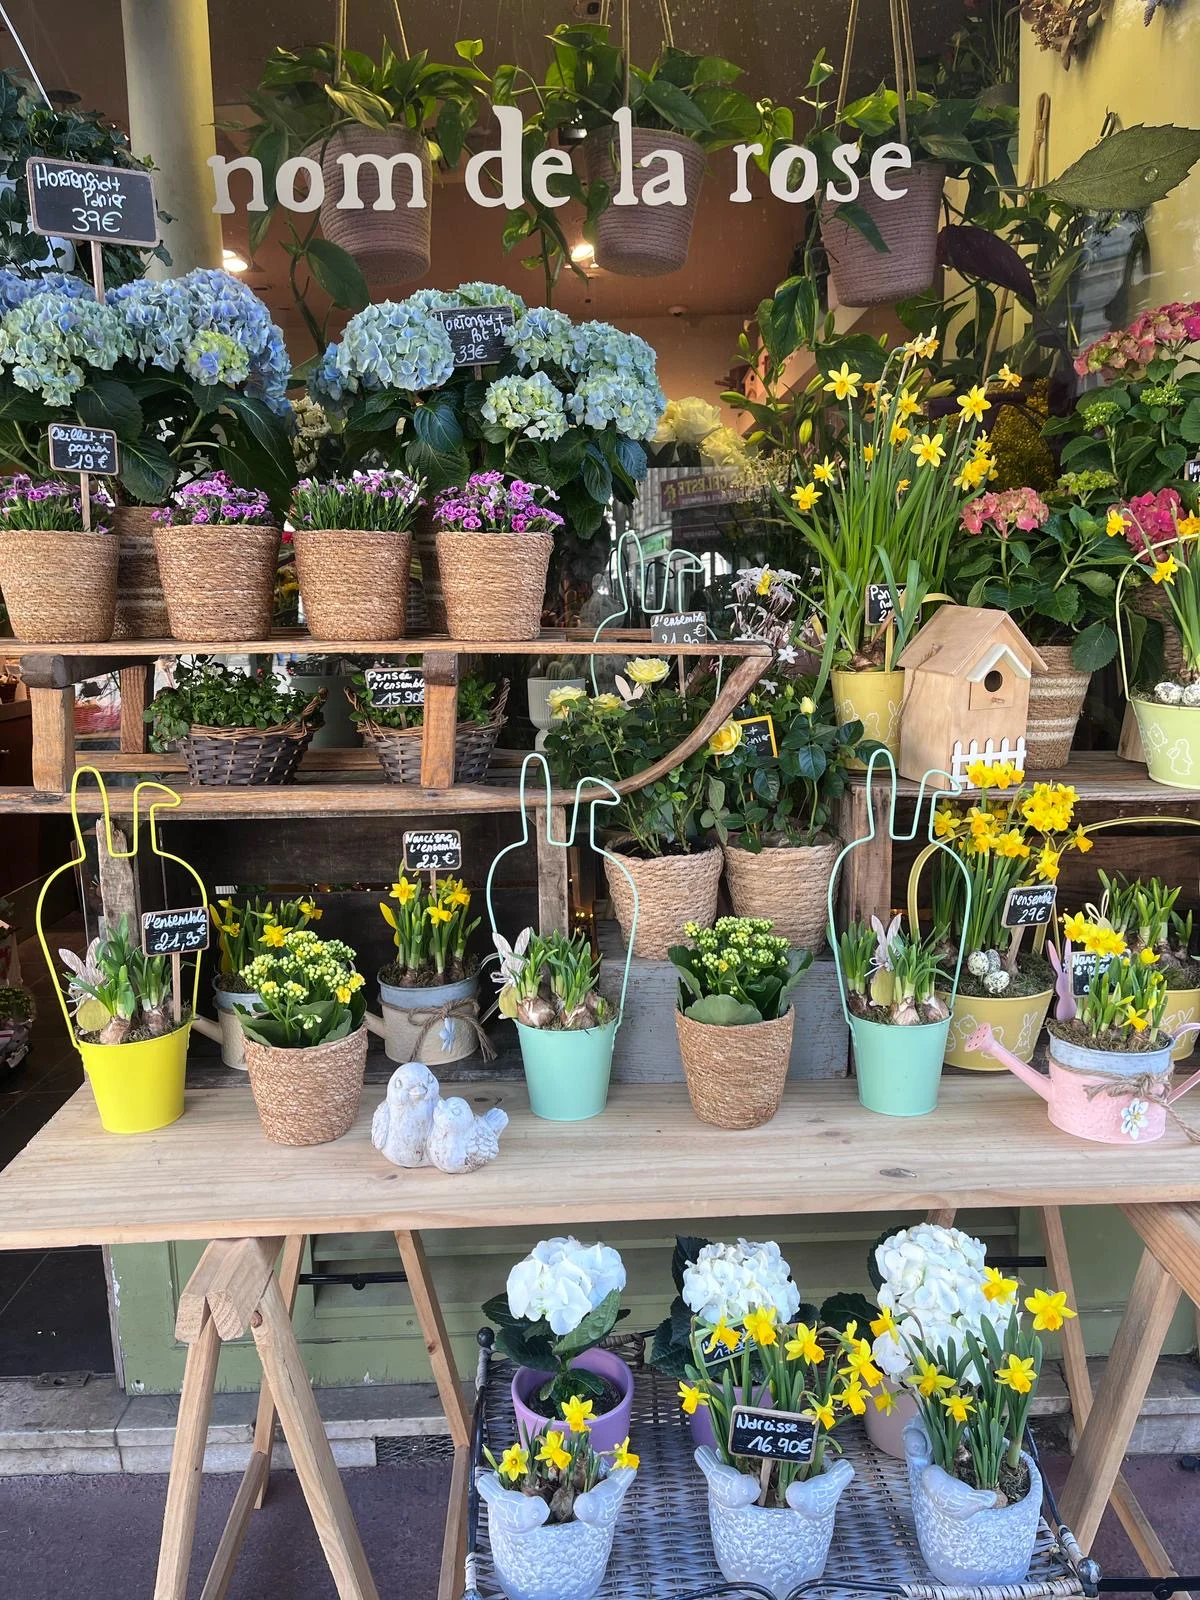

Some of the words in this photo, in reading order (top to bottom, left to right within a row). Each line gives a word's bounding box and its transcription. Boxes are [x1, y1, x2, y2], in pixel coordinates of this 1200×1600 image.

[207, 153, 427, 214] nom
[464, 105, 573, 210] de
[612, 106, 687, 206] la
[729, 142, 912, 203] rose
[82, 187, 127, 208] Panier
[71, 207, 123, 233] 39€
[471, 327, 490, 343] Pot
[455, 343, 488, 364] 39€
[68, 442, 111, 456] panier
[1017, 906, 1046, 924] 29€
[736, 1414, 798, 1433] Narcisse
[747, 1435, 813, 1454] 16.90€
